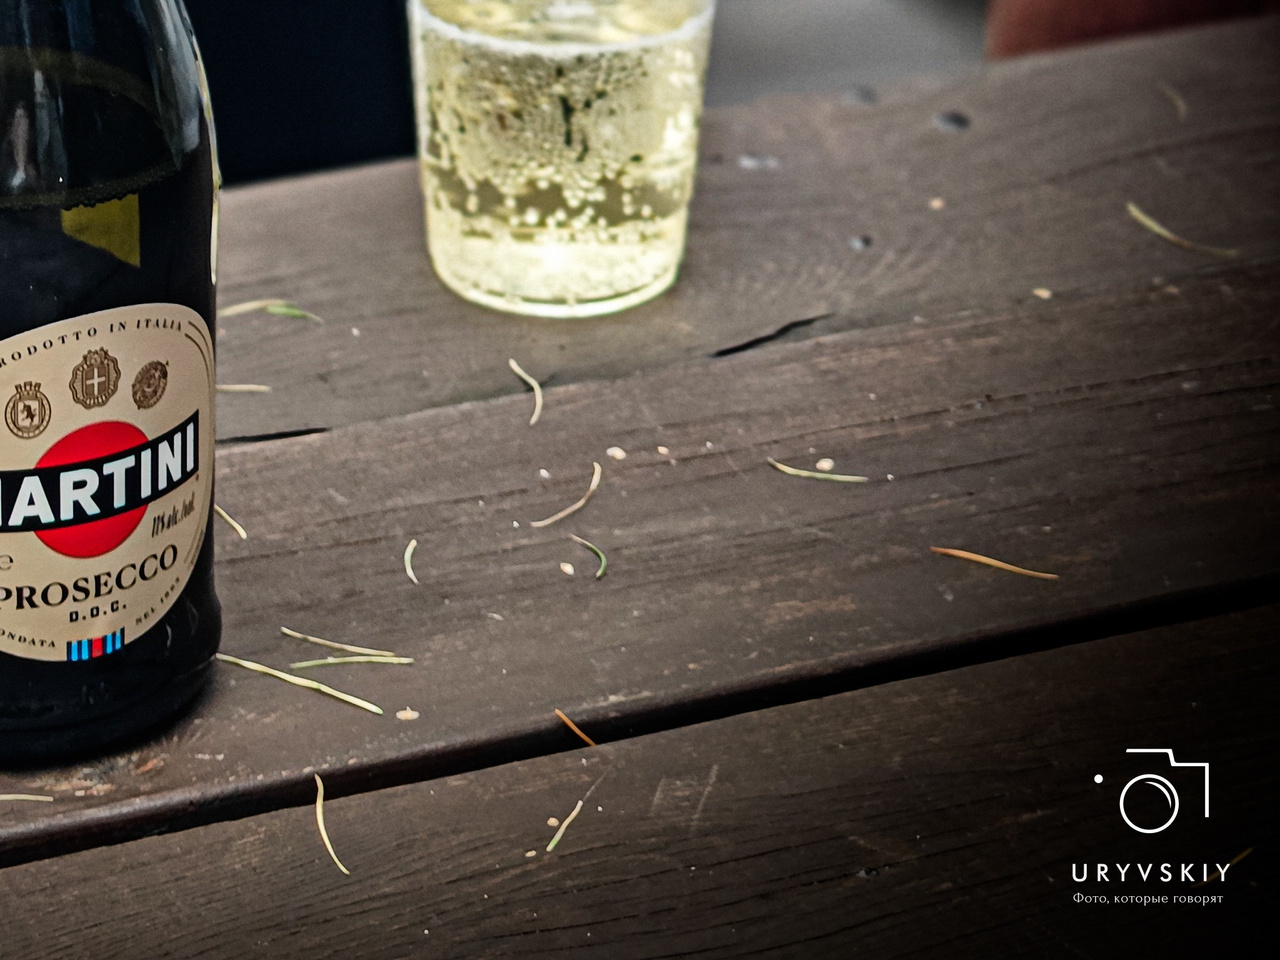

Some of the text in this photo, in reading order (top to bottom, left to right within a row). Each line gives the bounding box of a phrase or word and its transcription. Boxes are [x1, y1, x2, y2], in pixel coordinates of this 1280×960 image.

[109, 321, 127, 333] IN
[136, 318, 182, 332] ITALIA
[69, 600, 127, 623] D.O.C.
